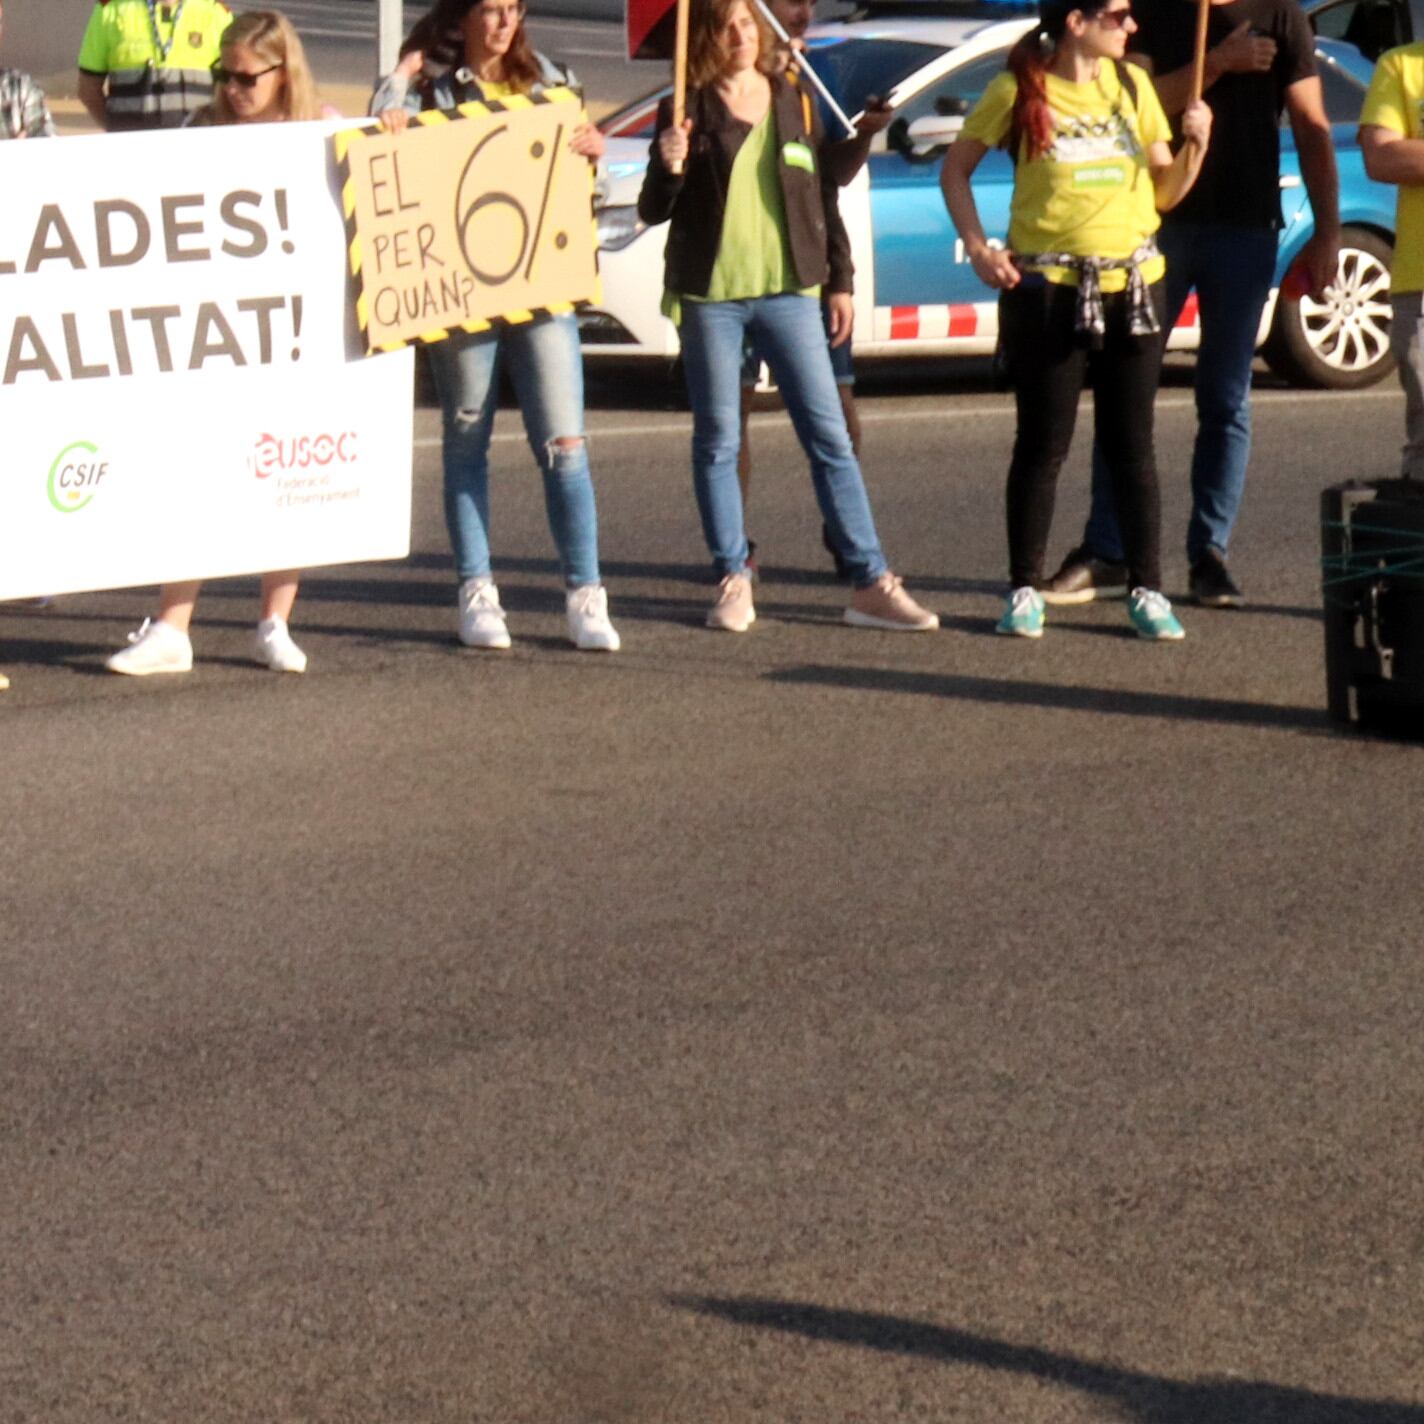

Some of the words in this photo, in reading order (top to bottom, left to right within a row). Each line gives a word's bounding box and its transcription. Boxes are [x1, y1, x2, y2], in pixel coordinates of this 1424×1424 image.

[369, 150, 420, 216] EL
[373, 224, 444, 274] PER
[374, 271, 475, 326] QUAN?
[59, 462, 109, 488] CSIF
